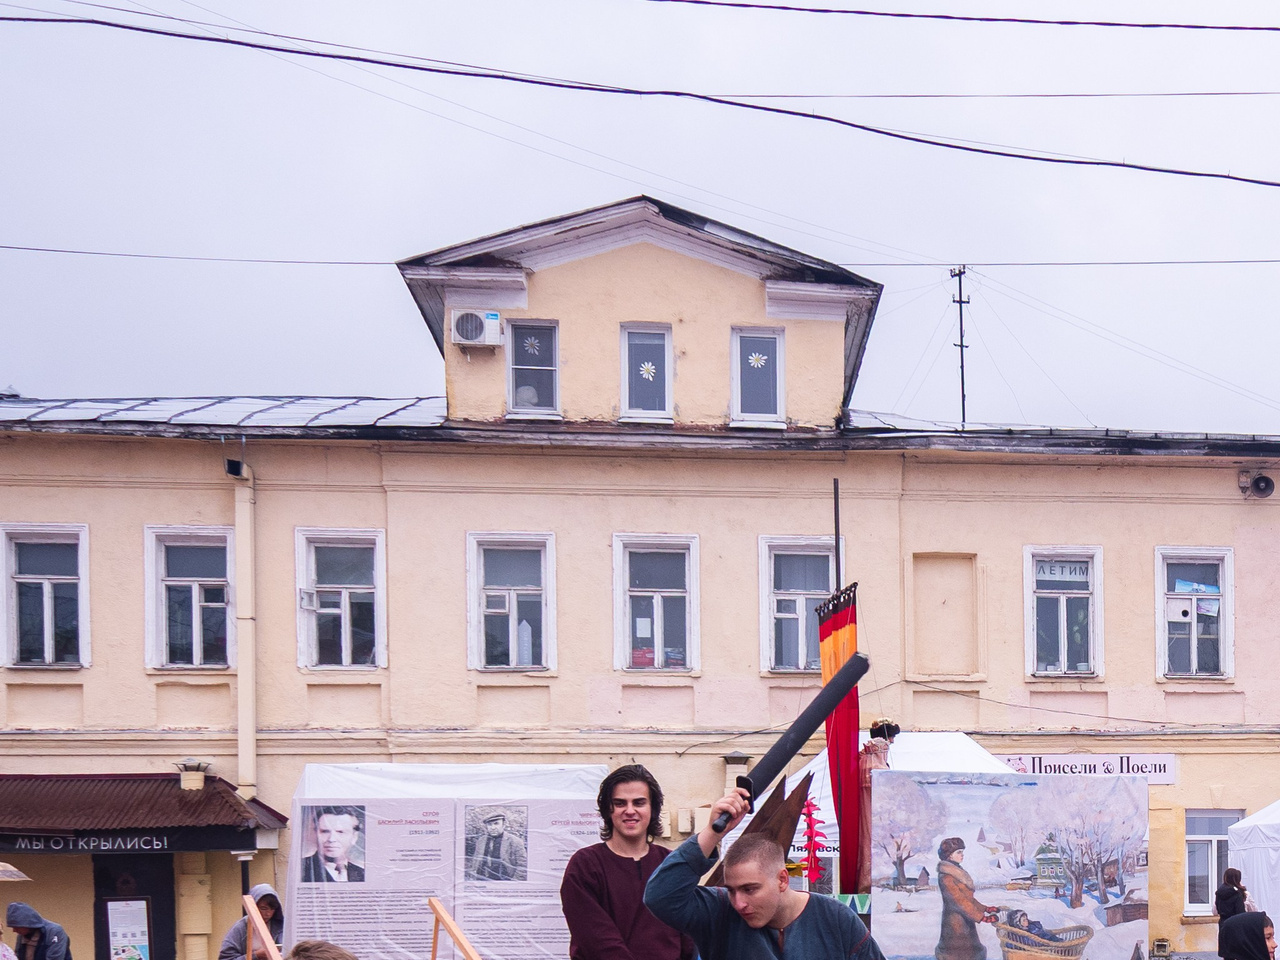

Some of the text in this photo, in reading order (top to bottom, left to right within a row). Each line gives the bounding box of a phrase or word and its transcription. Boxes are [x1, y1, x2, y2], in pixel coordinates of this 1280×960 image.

[1038, 565, 1089, 577] ЛЕТИМ
[1031, 756, 1097, 775] Присели
[1119, 755, 1167, 774] Поели
[16, 836, 169, 849] МЫ ОТКРЫЛИСЬ!
